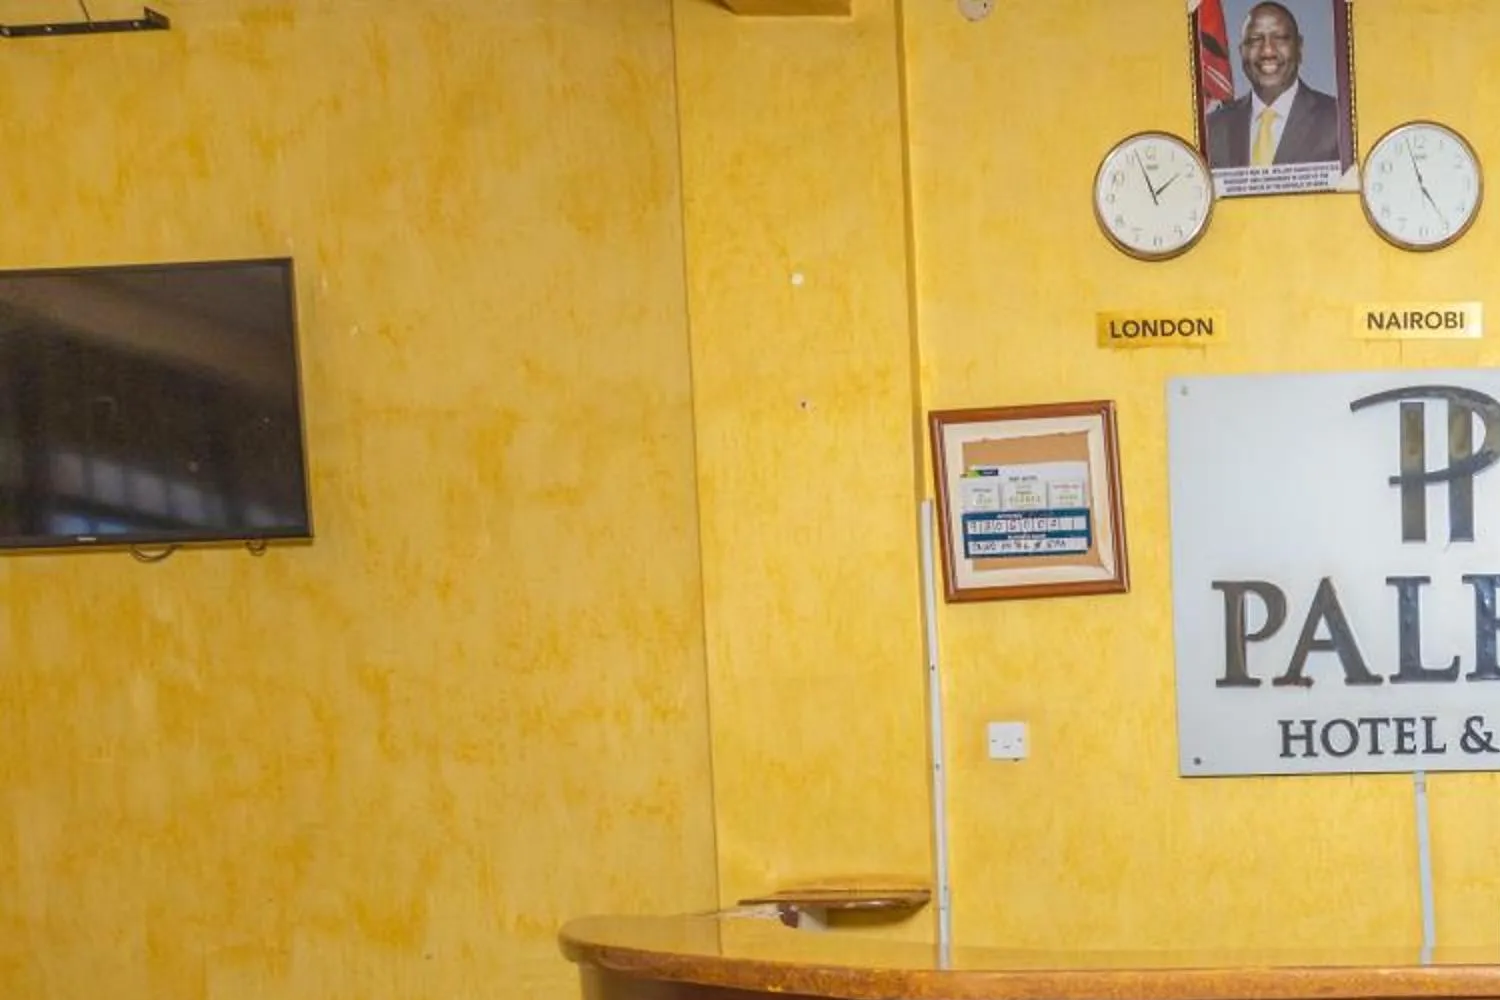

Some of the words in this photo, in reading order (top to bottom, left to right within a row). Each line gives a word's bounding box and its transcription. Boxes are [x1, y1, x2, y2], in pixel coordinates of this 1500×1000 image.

[1110, 318, 1214, 338] LONDON
[1367, 311, 1465, 331] NAIROBI
[1278, 716, 1447, 758] HOTEL
[1459, 715, 1499, 753] &
